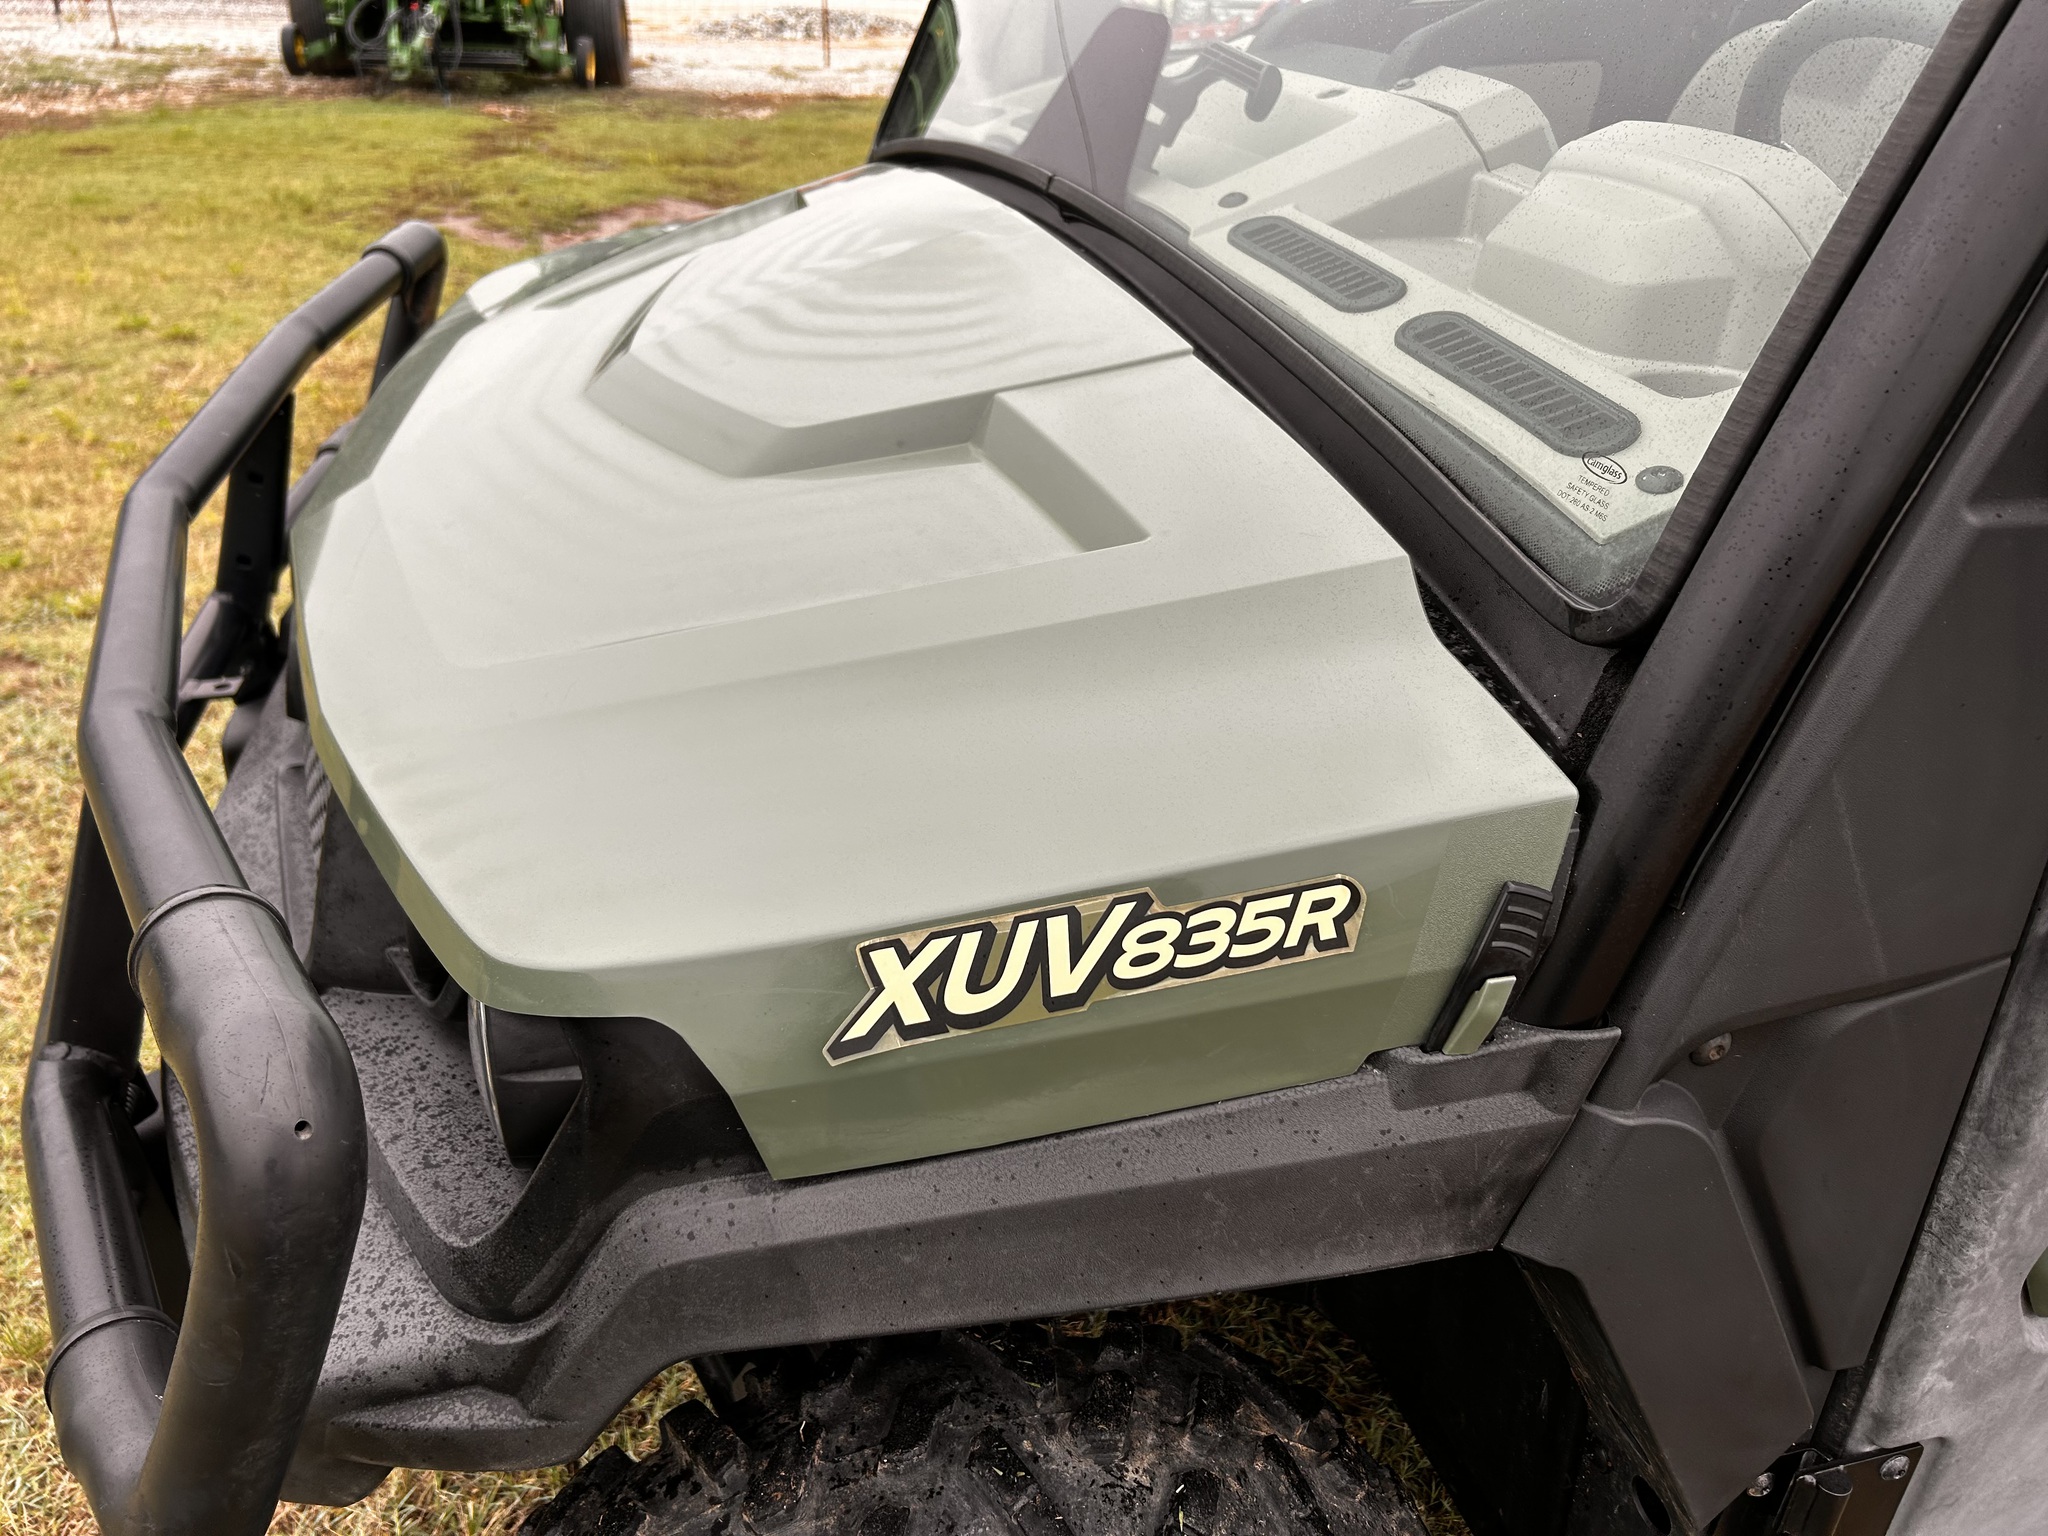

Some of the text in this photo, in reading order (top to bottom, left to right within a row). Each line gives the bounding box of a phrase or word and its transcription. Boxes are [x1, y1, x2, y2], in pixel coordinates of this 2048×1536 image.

[1566, 481, 1610, 510] SAFETY GLASS
[1578, 475, 1610, 496] TEMPERED
